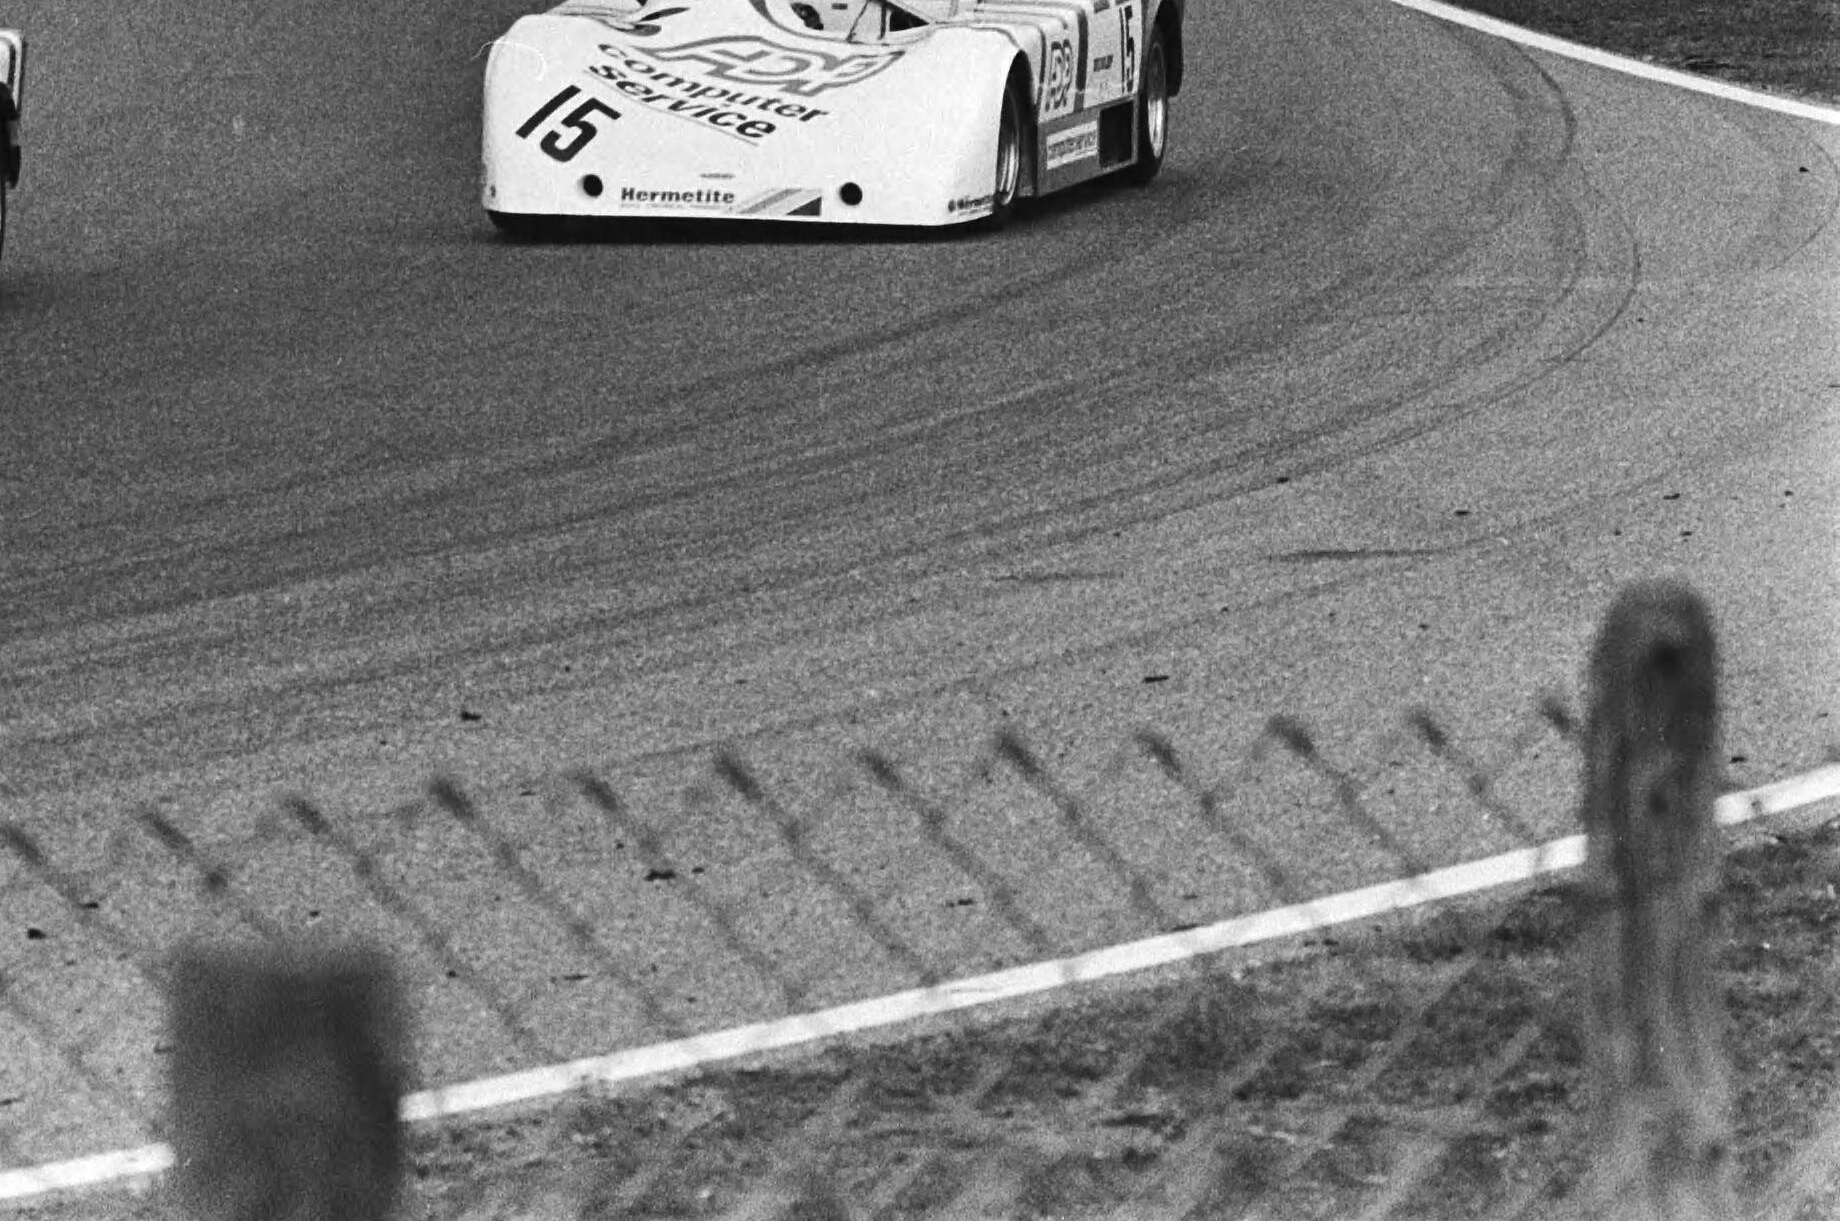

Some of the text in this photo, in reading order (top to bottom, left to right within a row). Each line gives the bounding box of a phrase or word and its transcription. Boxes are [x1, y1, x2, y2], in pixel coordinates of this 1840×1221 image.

[597, 43, 829, 124] computer
[1118, 4, 1136, 94] 15
[514, 84, 623, 163] 15
[588, 64, 777, 139] service
[620, 186, 735, 204] Hermetite
